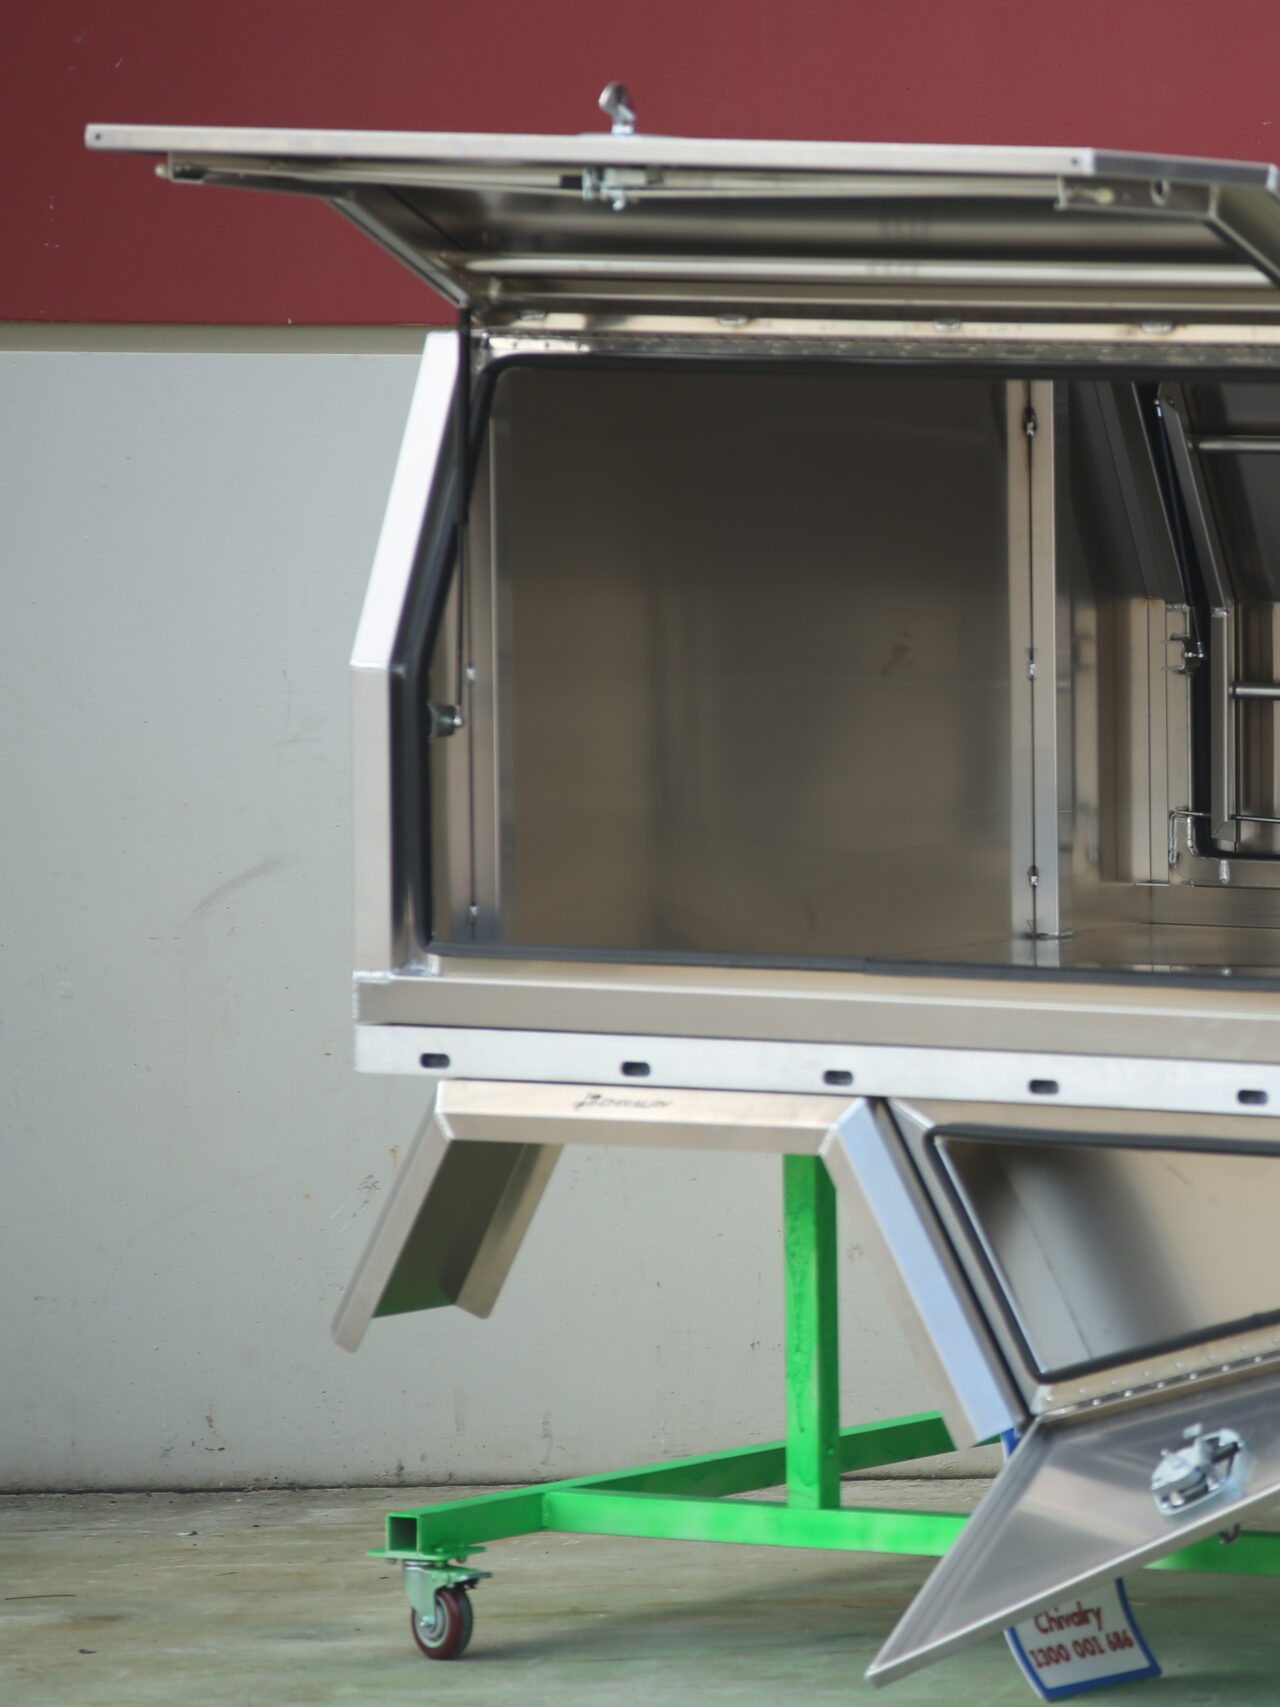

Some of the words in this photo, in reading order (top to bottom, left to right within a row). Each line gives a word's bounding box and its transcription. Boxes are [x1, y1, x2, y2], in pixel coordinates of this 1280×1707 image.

[1034, 1601, 1103, 1634] Chivalry
[1029, 1644, 1070, 1668] 1300
[1072, 1637, 1105, 1659] 001
[1106, 1630, 1134, 1651] 686
